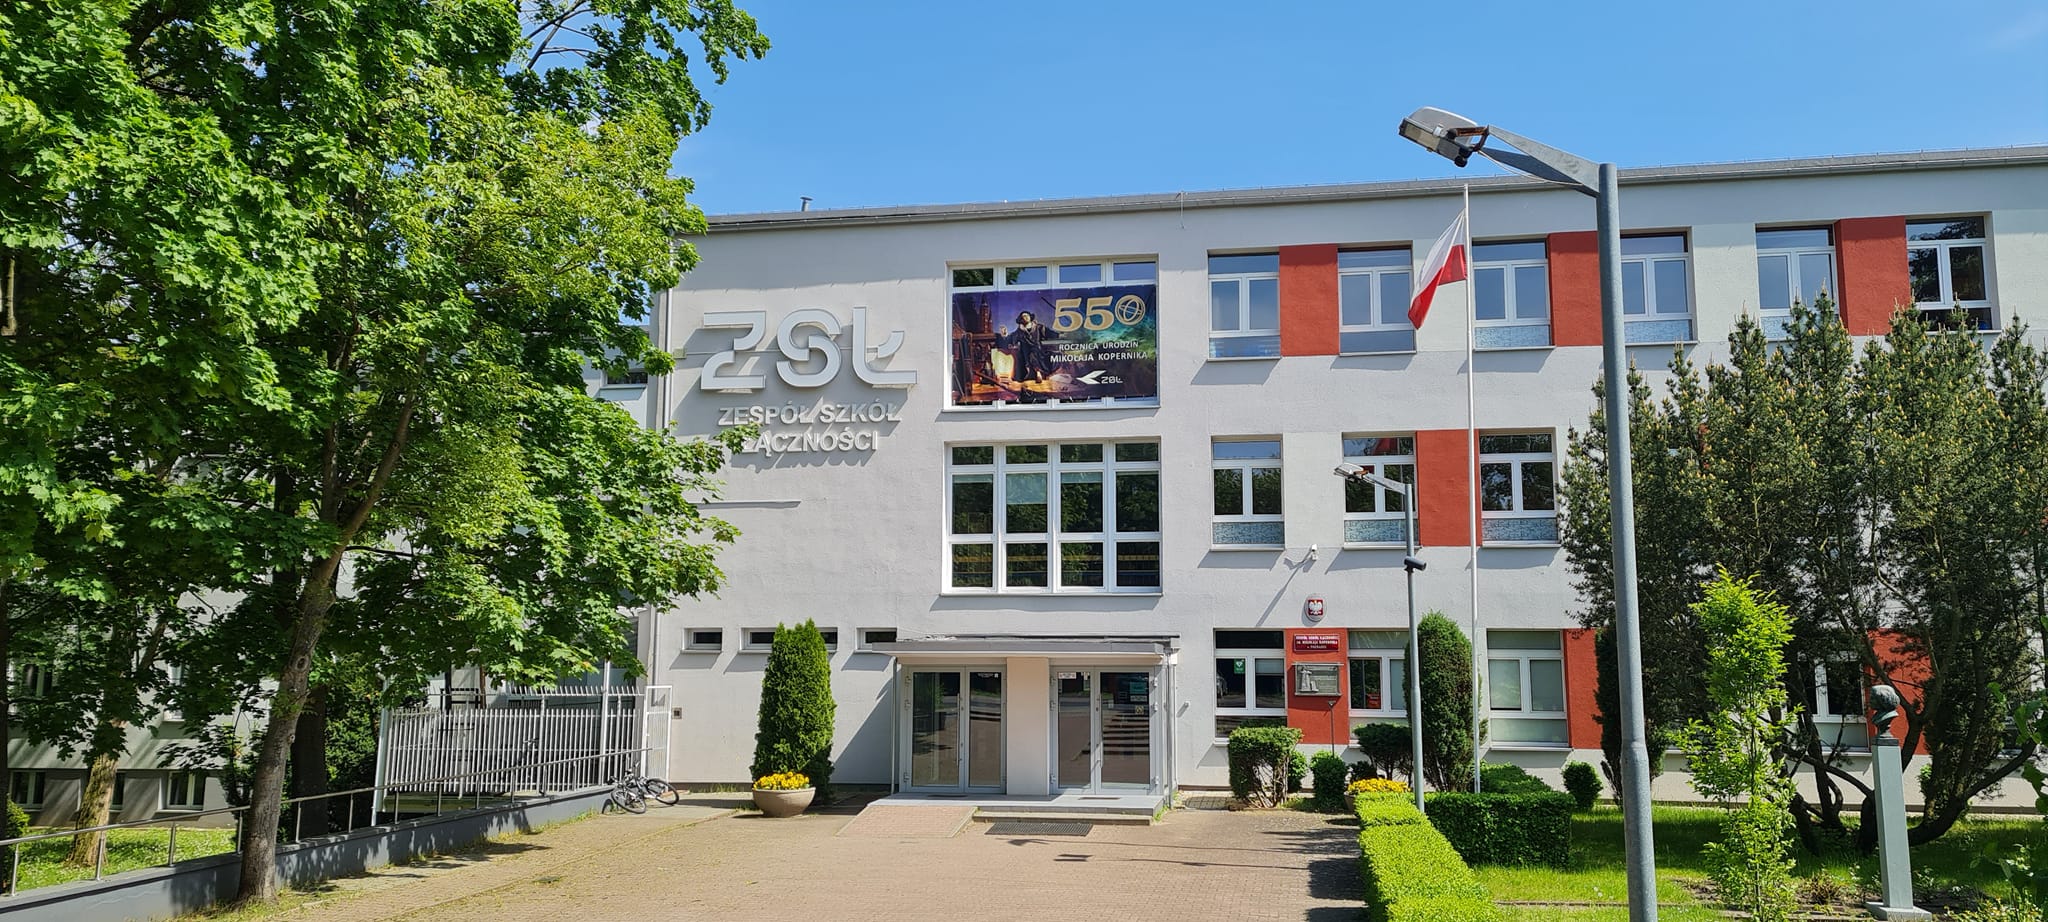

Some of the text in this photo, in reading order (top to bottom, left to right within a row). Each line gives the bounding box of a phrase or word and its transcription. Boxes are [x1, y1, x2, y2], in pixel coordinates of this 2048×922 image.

[1052, 294, 1146, 332] 550
[1058, 340, 1139, 351] ROCZNICA URODZIN
[1050, 351, 1148, 363] MIKOŁAJA KOPERNIKA
[718, 398, 903, 426] ZESPÓŁ SZKÓŁ
